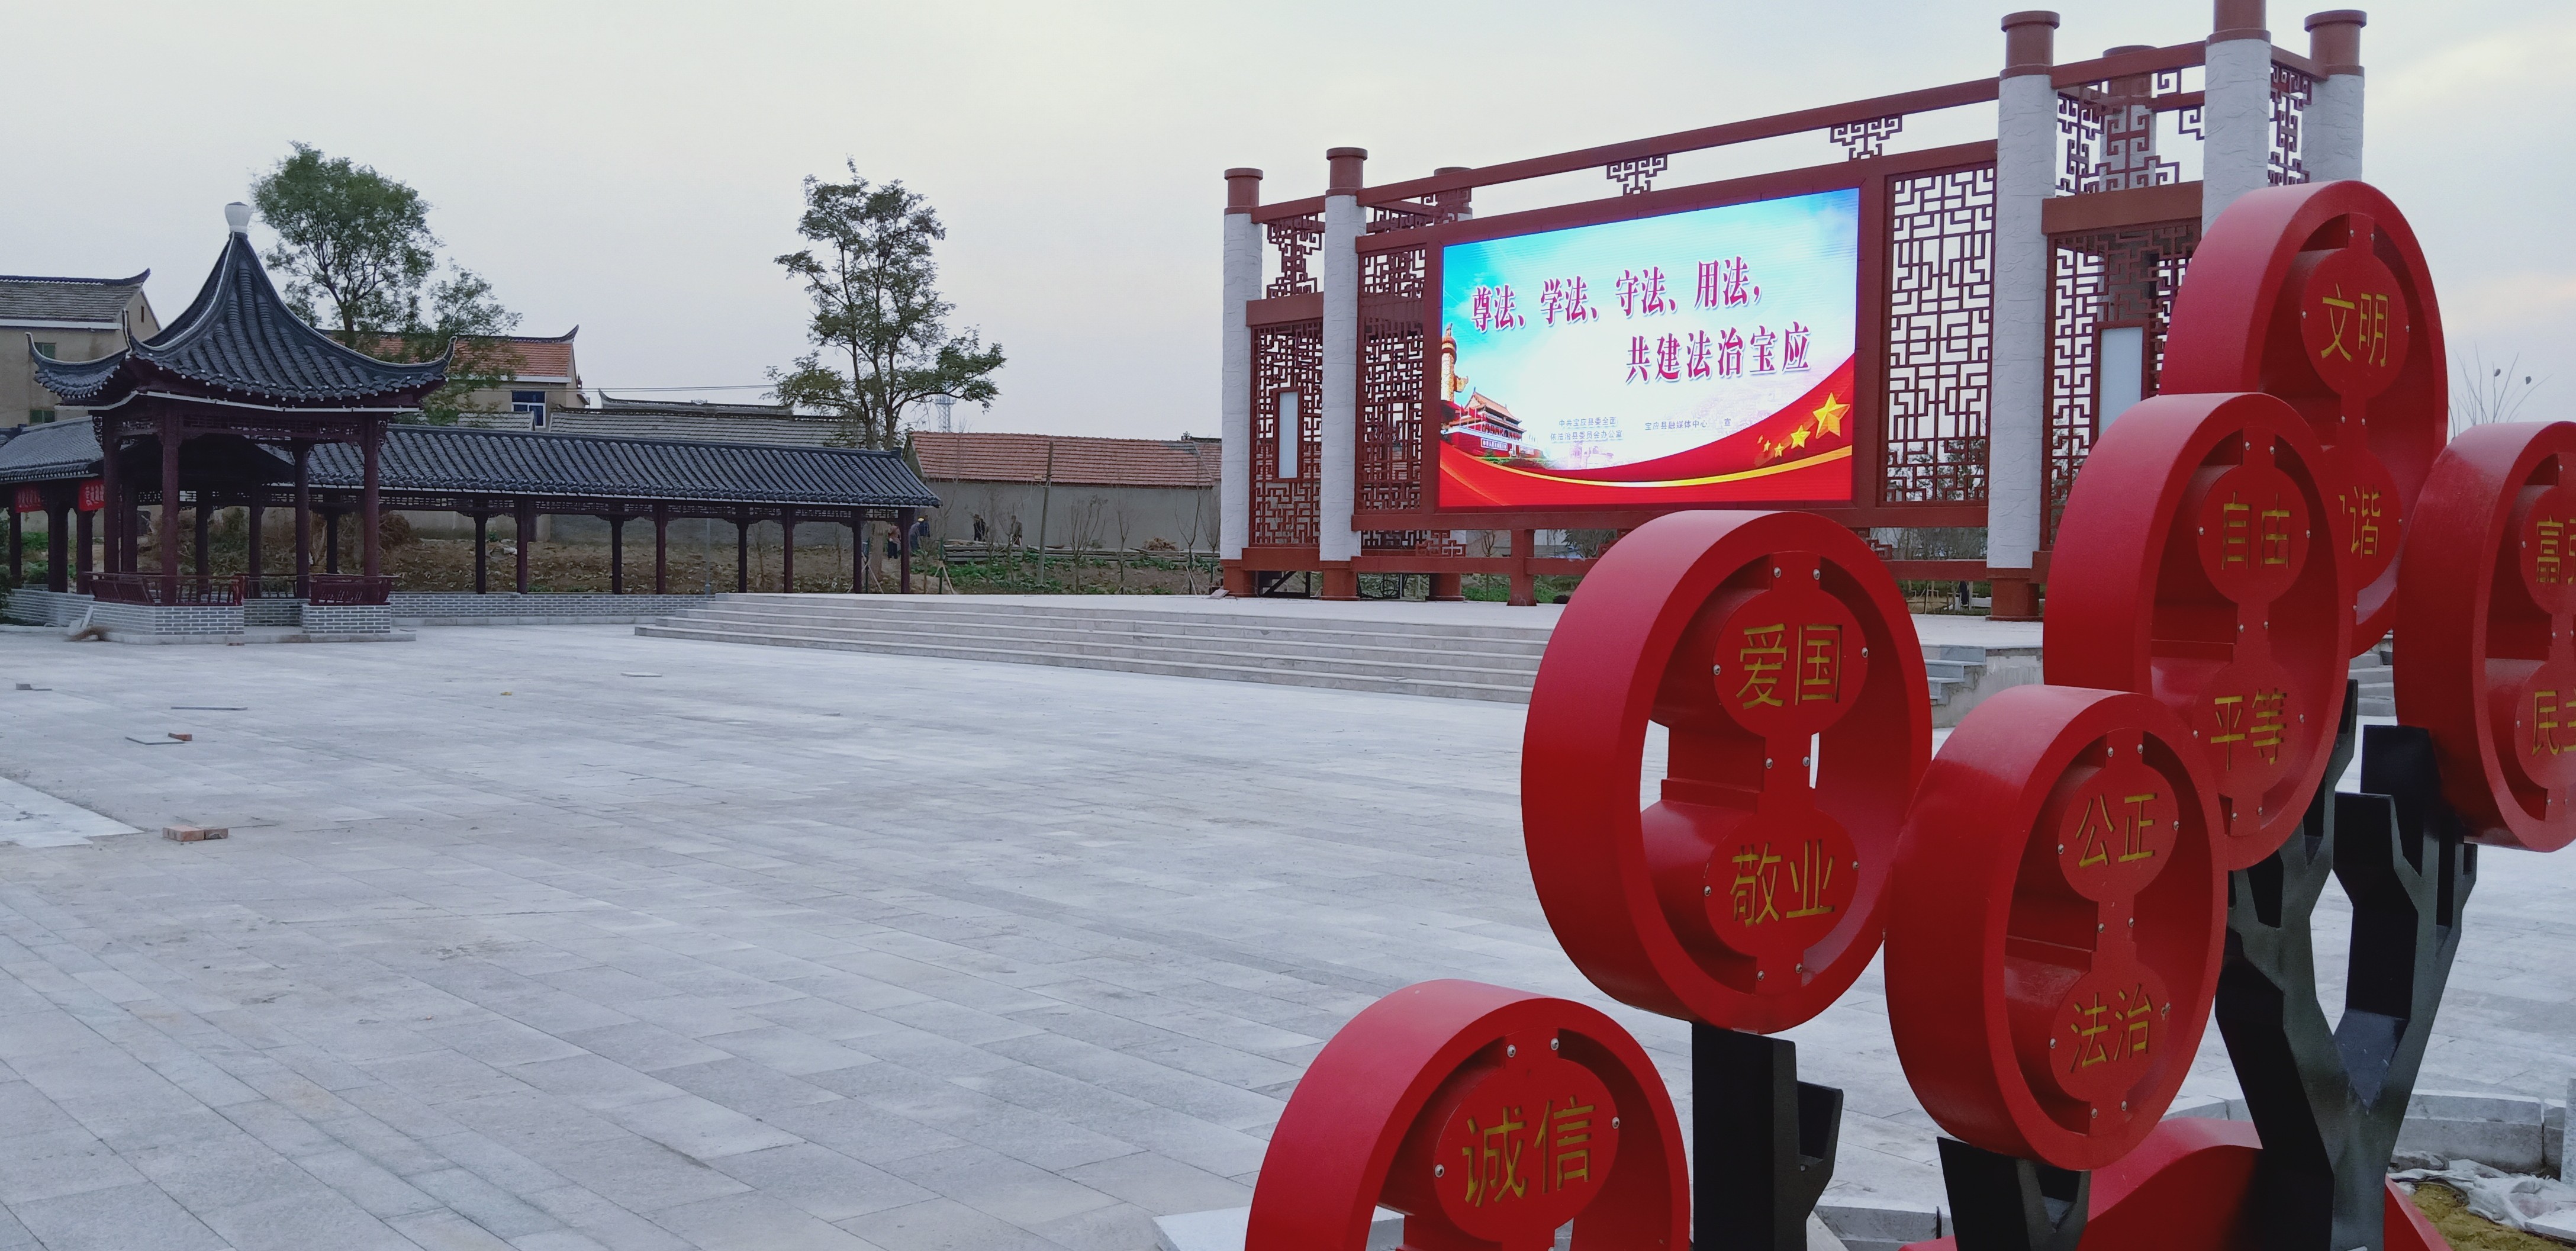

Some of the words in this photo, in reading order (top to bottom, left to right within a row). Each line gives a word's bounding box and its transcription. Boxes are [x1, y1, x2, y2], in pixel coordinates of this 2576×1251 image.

[1625, 321, 1810, 382] 共建法治宝应
[2321, 282, 2388, 367] 文明
[1559, 416, 1617, 427] 中共宝应县委全面
[1645, 420, 1708, 430] 宝应县融媒体中心
[1724, 418, 1731, 426] 宣
[2221, 491, 2291, 570] 自由
[2339, 484, 2381, 559] 谐
[1735, 622, 1843, 710] 爱国
[2210, 687, 2287, 771] 平等
[2075, 793, 2157, 868] 公正
[1729, 838, 1836, 928] 敬业
[2069, 983, 2153, 1074] 法治
[1462, 1095, 1596, 1208] 诚信
